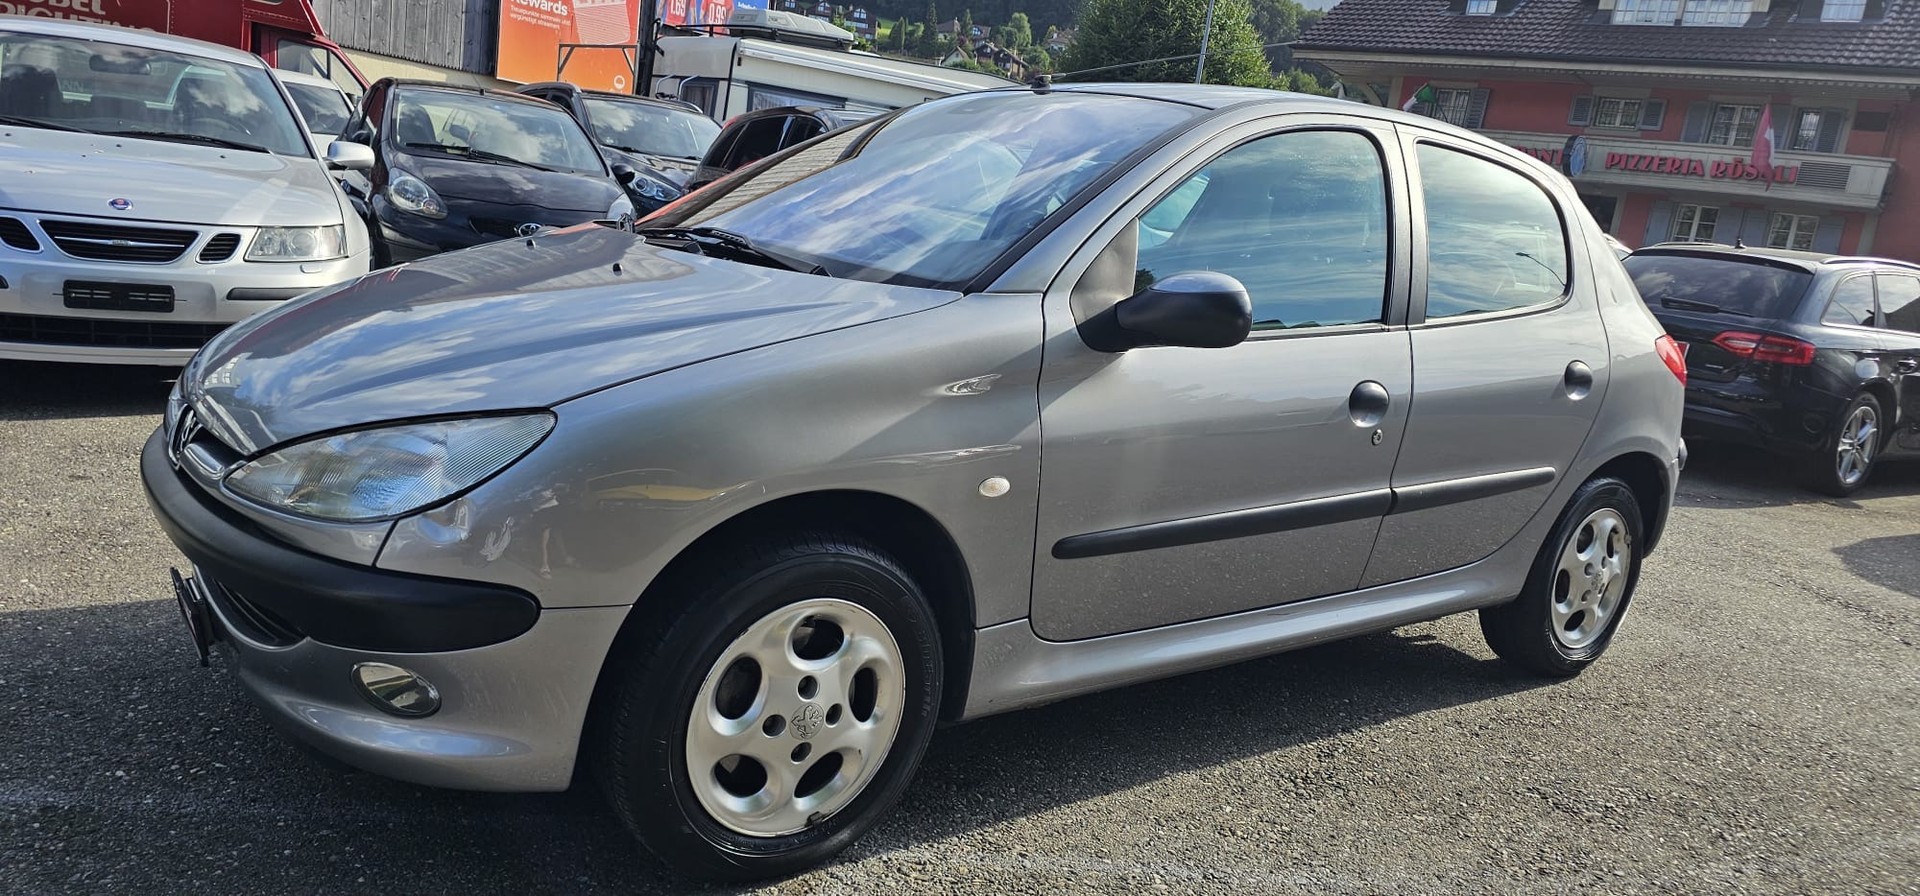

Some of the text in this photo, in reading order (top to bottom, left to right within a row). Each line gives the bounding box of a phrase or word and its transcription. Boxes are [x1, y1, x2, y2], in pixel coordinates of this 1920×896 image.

[511, 0, 568, 16] ewards
[1604, 152, 1798, 184] PIZZERIA RÖSLI
